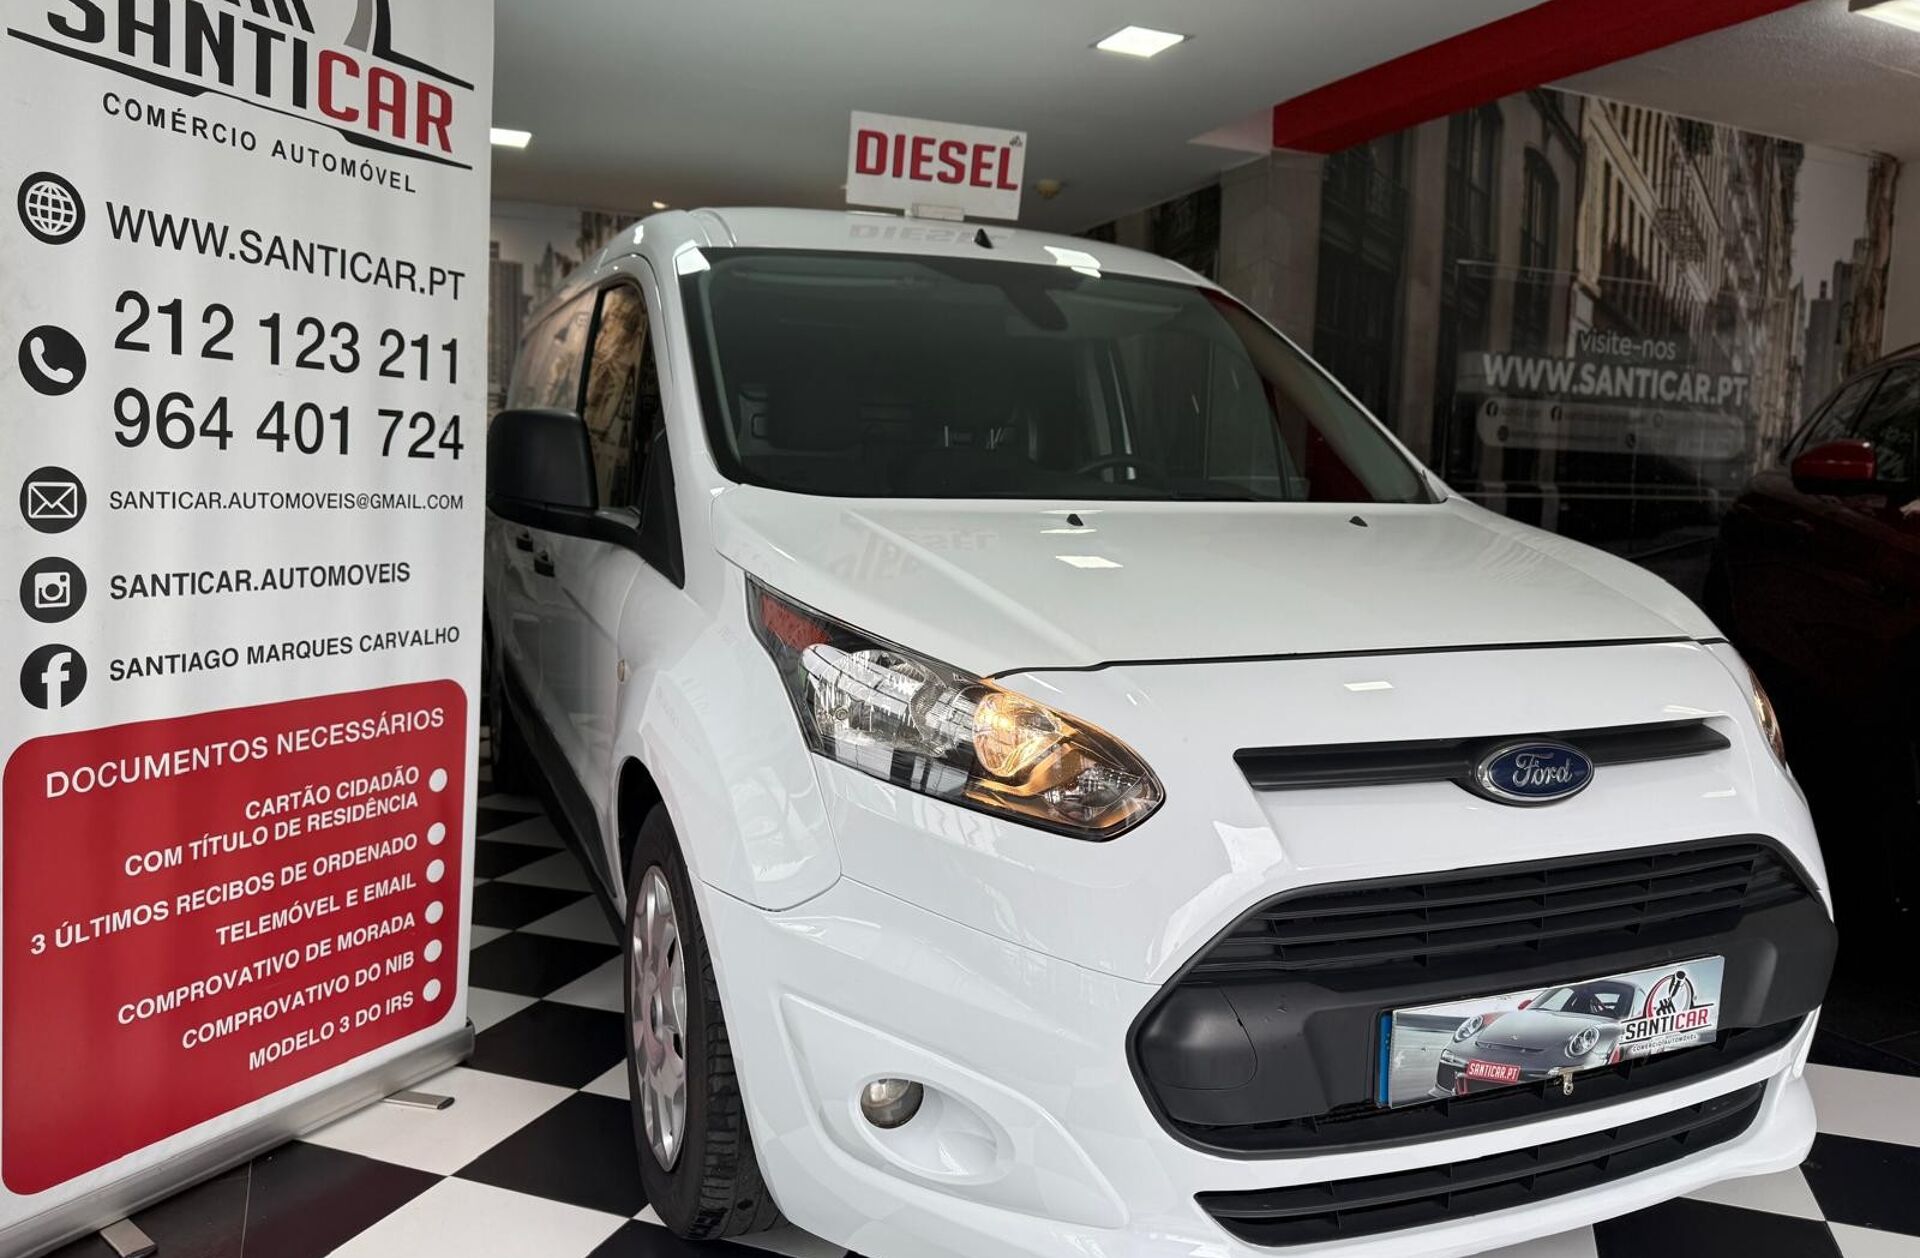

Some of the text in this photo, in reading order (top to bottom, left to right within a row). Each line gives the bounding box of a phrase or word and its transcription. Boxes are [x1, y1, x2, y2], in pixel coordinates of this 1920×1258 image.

[103, 92, 417, 193] COMÉRCIO AUTOMÓVEL
[855, 129, 1018, 191] DIESEL
[106, 201, 466, 300] WWW.SANTICAR.PT
[114, 290, 458, 385] 212 123 211
[1579, 329, 1676, 360] visite-nos
[1482, 353, 1749, 406] WWW.SANTICAR.PT
[113, 387, 465, 460] 964 401 724
[109, 490, 464, 510] SANTICAR.AUTOMOVEIS@GMAIL.COM
[110, 562, 411, 600] SANTICAR.AUTOMOVEIS
[109, 626, 460, 681] SANTIAGO MARQUES CARVALHO
[46, 707, 445, 798] DOCUMENTOS NECESSÁRIOS
[1512, 752, 1573, 787] Ford
[245, 765, 420, 820] CARTÃO CIDADÃO
[124, 791, 418, 877] COM TÍTULO DE RESIDÊNCIA
[30, 833, 418, 955] 3 ÚLTIMOS RECIBOS DE ORDENADO
[216, 872, 417, 946] TELEMÓVEL E EMAIL
[117, 911, 415, 1025] COMPROVATIVO DE MORADA
[182, 951, 414, 1050] COMPROVATIVO DO NIB
[249, 990, 414, 1071] MODELO 3 DO IRS
[1625, 1010, 1708, 1040] SANTICAR
[1468, 1063, 1518, 1080] SANTICAR.PT
